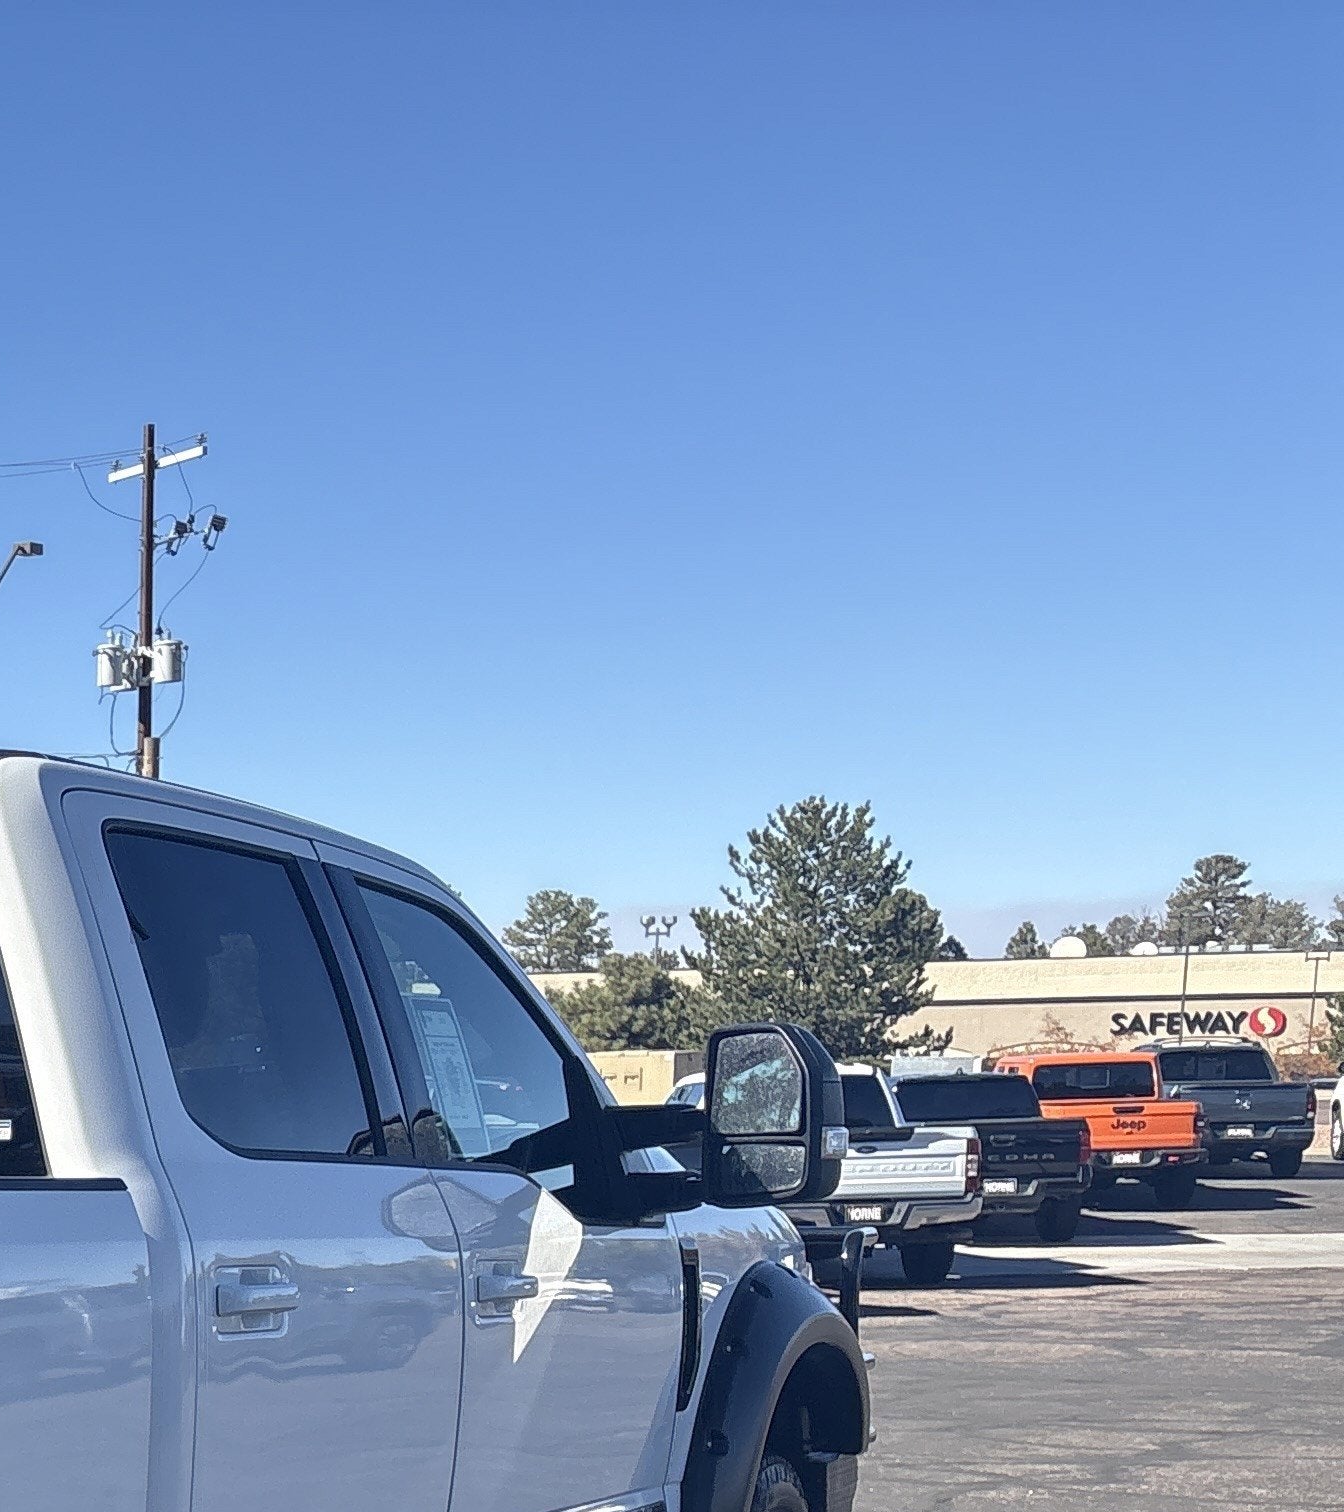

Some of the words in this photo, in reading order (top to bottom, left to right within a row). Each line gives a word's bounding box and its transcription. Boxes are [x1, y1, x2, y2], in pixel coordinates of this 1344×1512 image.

[1110, 1011, 1249, 1036] SAFEWAY
[1111, 1118, 1147, 1131] Jeep
[987, 1153, 1056, 1161] COMA
